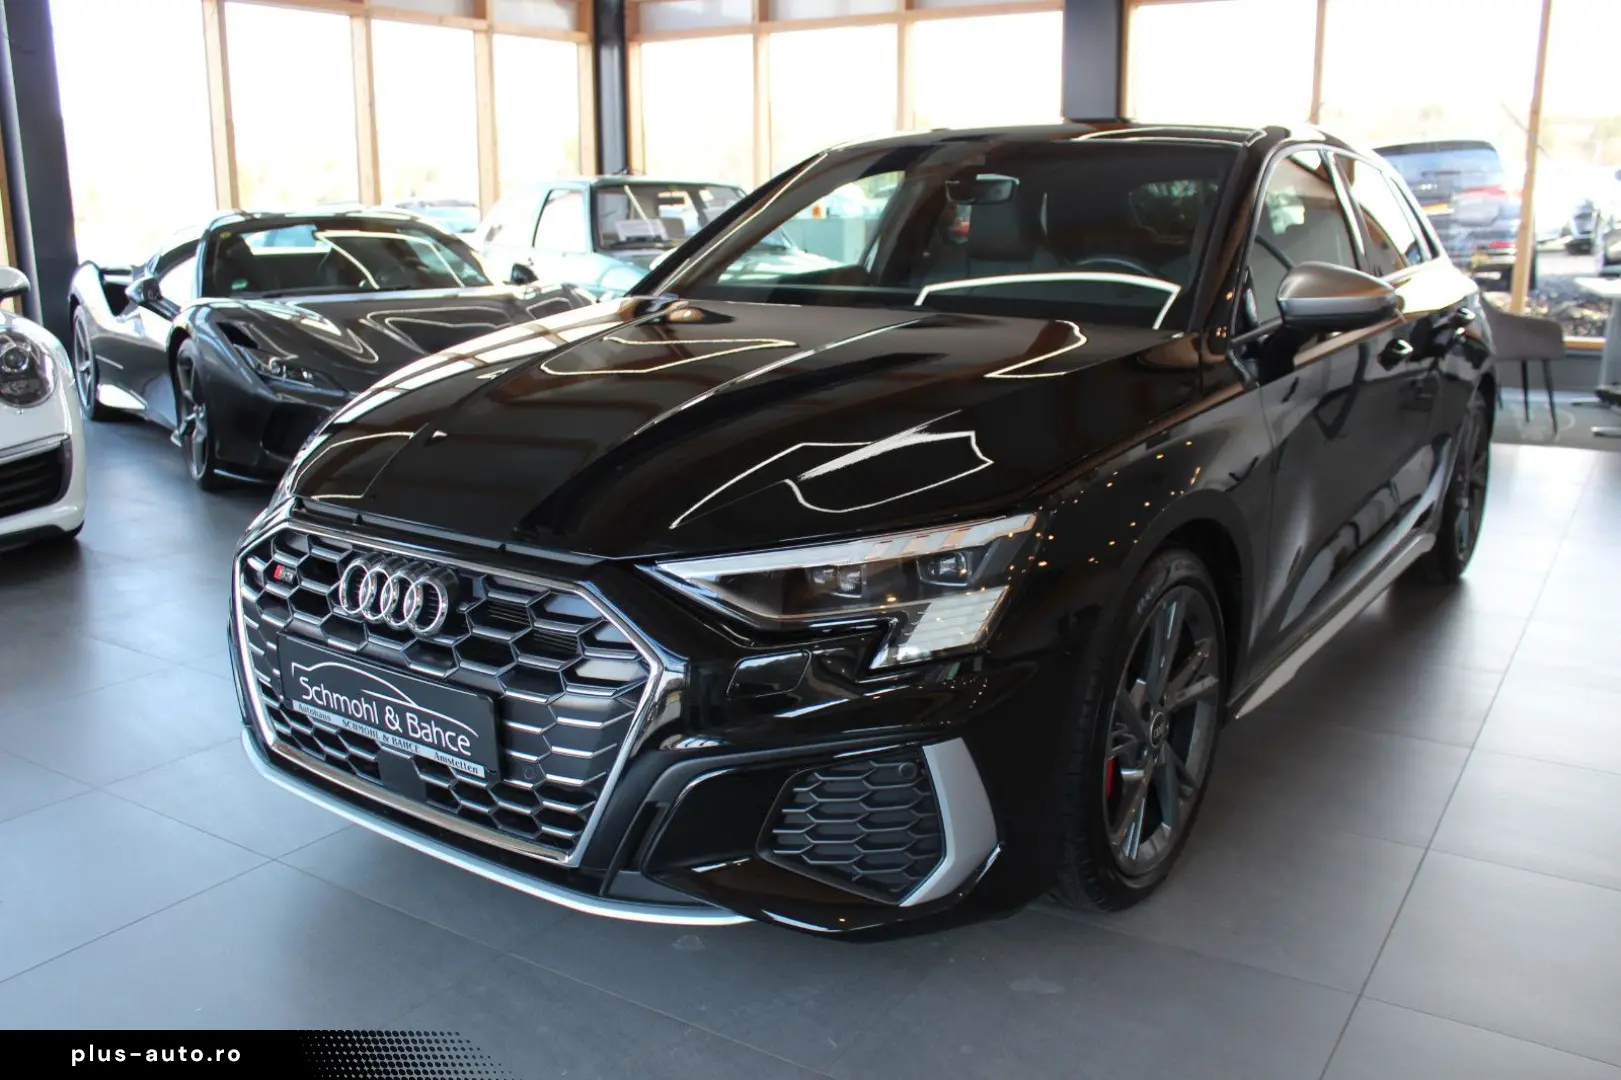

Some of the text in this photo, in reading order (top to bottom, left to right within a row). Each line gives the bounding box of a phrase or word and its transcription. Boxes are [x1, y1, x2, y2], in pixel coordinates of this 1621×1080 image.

[298, 703, 479, 775] Autohaus SCHMOHL & BAHCE Amstetten
[299, 676, 472, 756] Schmohl & Bahce
